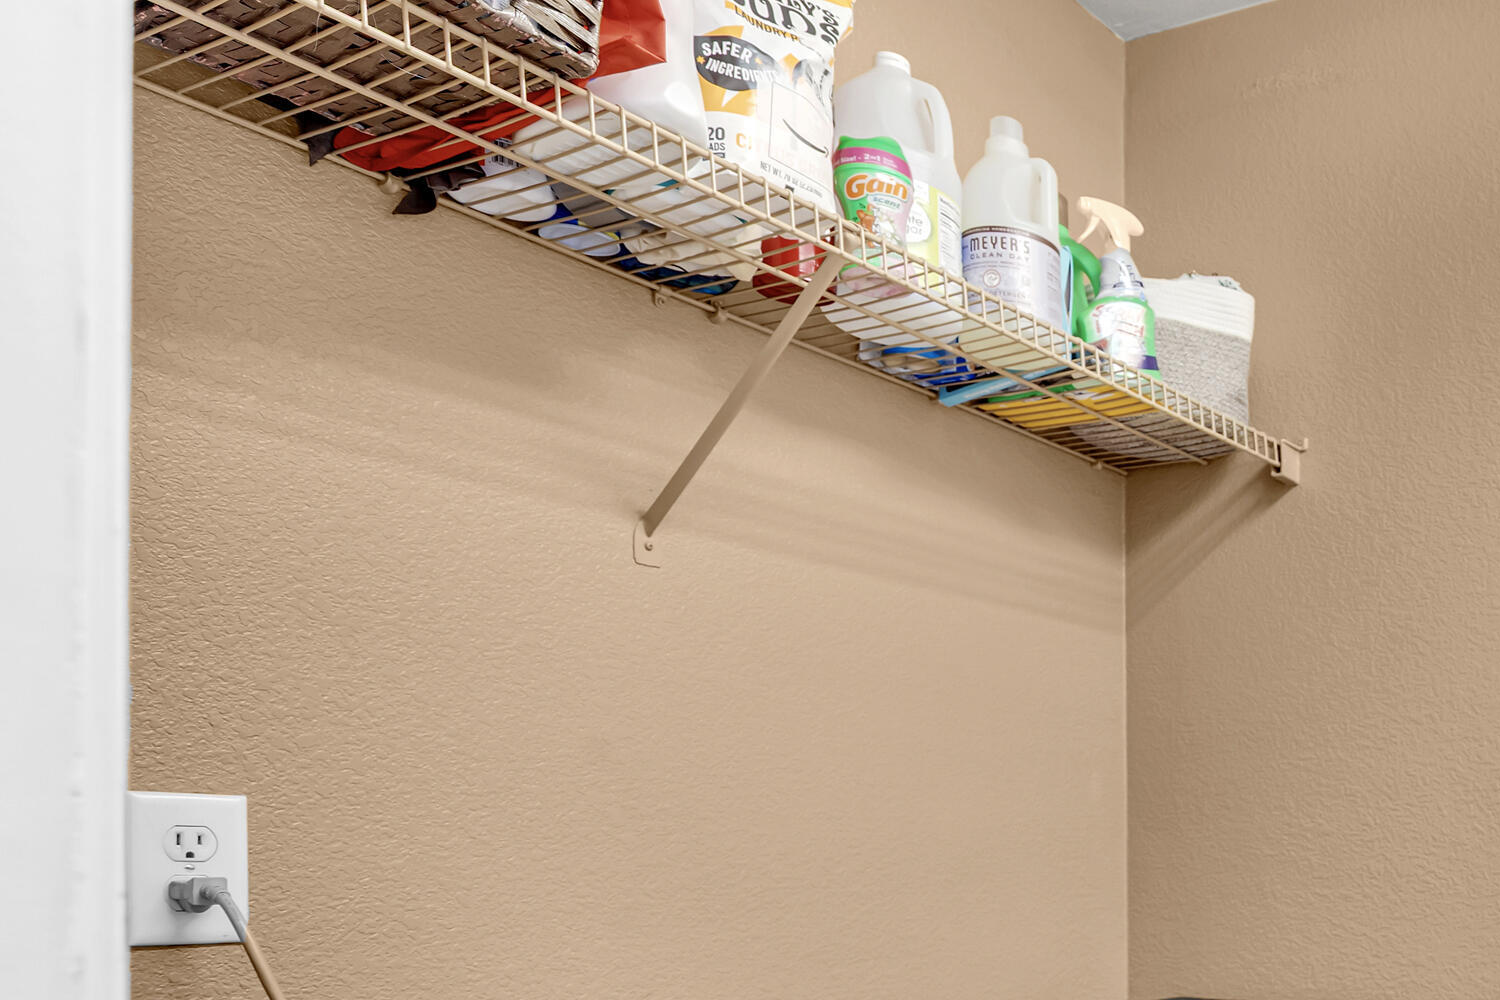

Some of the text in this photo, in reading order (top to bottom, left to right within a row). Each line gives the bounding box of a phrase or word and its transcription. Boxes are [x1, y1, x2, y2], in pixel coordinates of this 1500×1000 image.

[701, 41, 752, 64] SAFER
[844, 174, 908, 200] Gain
[970, 252, 1003, 260] CLEAN
